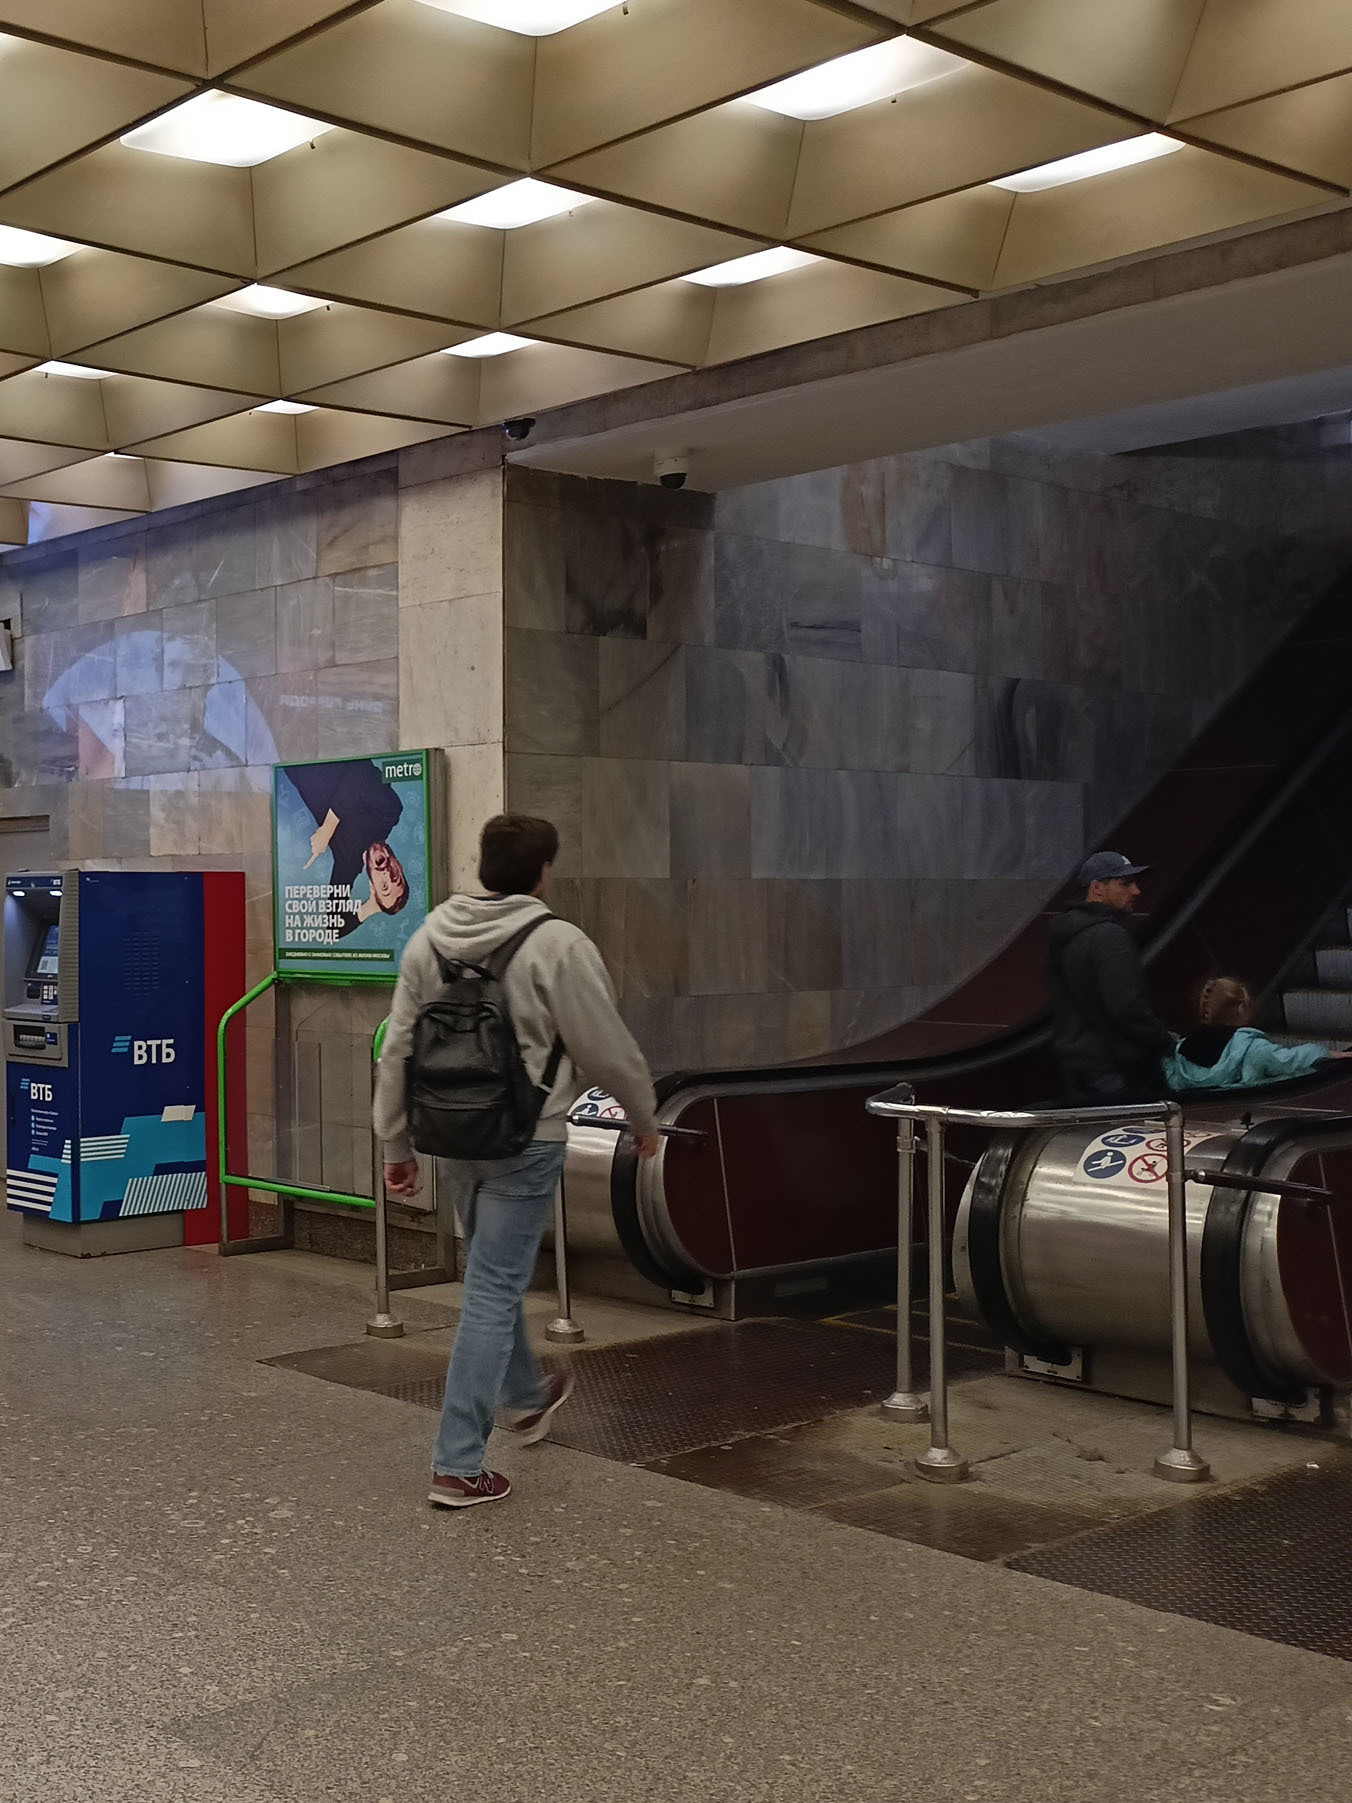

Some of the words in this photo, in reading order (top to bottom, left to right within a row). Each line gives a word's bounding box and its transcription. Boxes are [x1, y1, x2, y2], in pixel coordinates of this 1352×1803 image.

[385, 762, 422, 778] metro
[285, 884, 351, 899] ПЕРЕВЕРНИ
[285, 897, 316, 913] СВОЙ
[318, 899, 362, 916] ВЗГЛЯД
[285, 914, 302, 928] НА
[303, 914, 345, 928] ЖИЗНЬ
[285, 929, 293, 942] В
[294, 929, 340, 945] ГОРОДЕ
[133, 1039, 176, 1065] ВТБ
[30, 1082, 53, 1101] ВТБ
